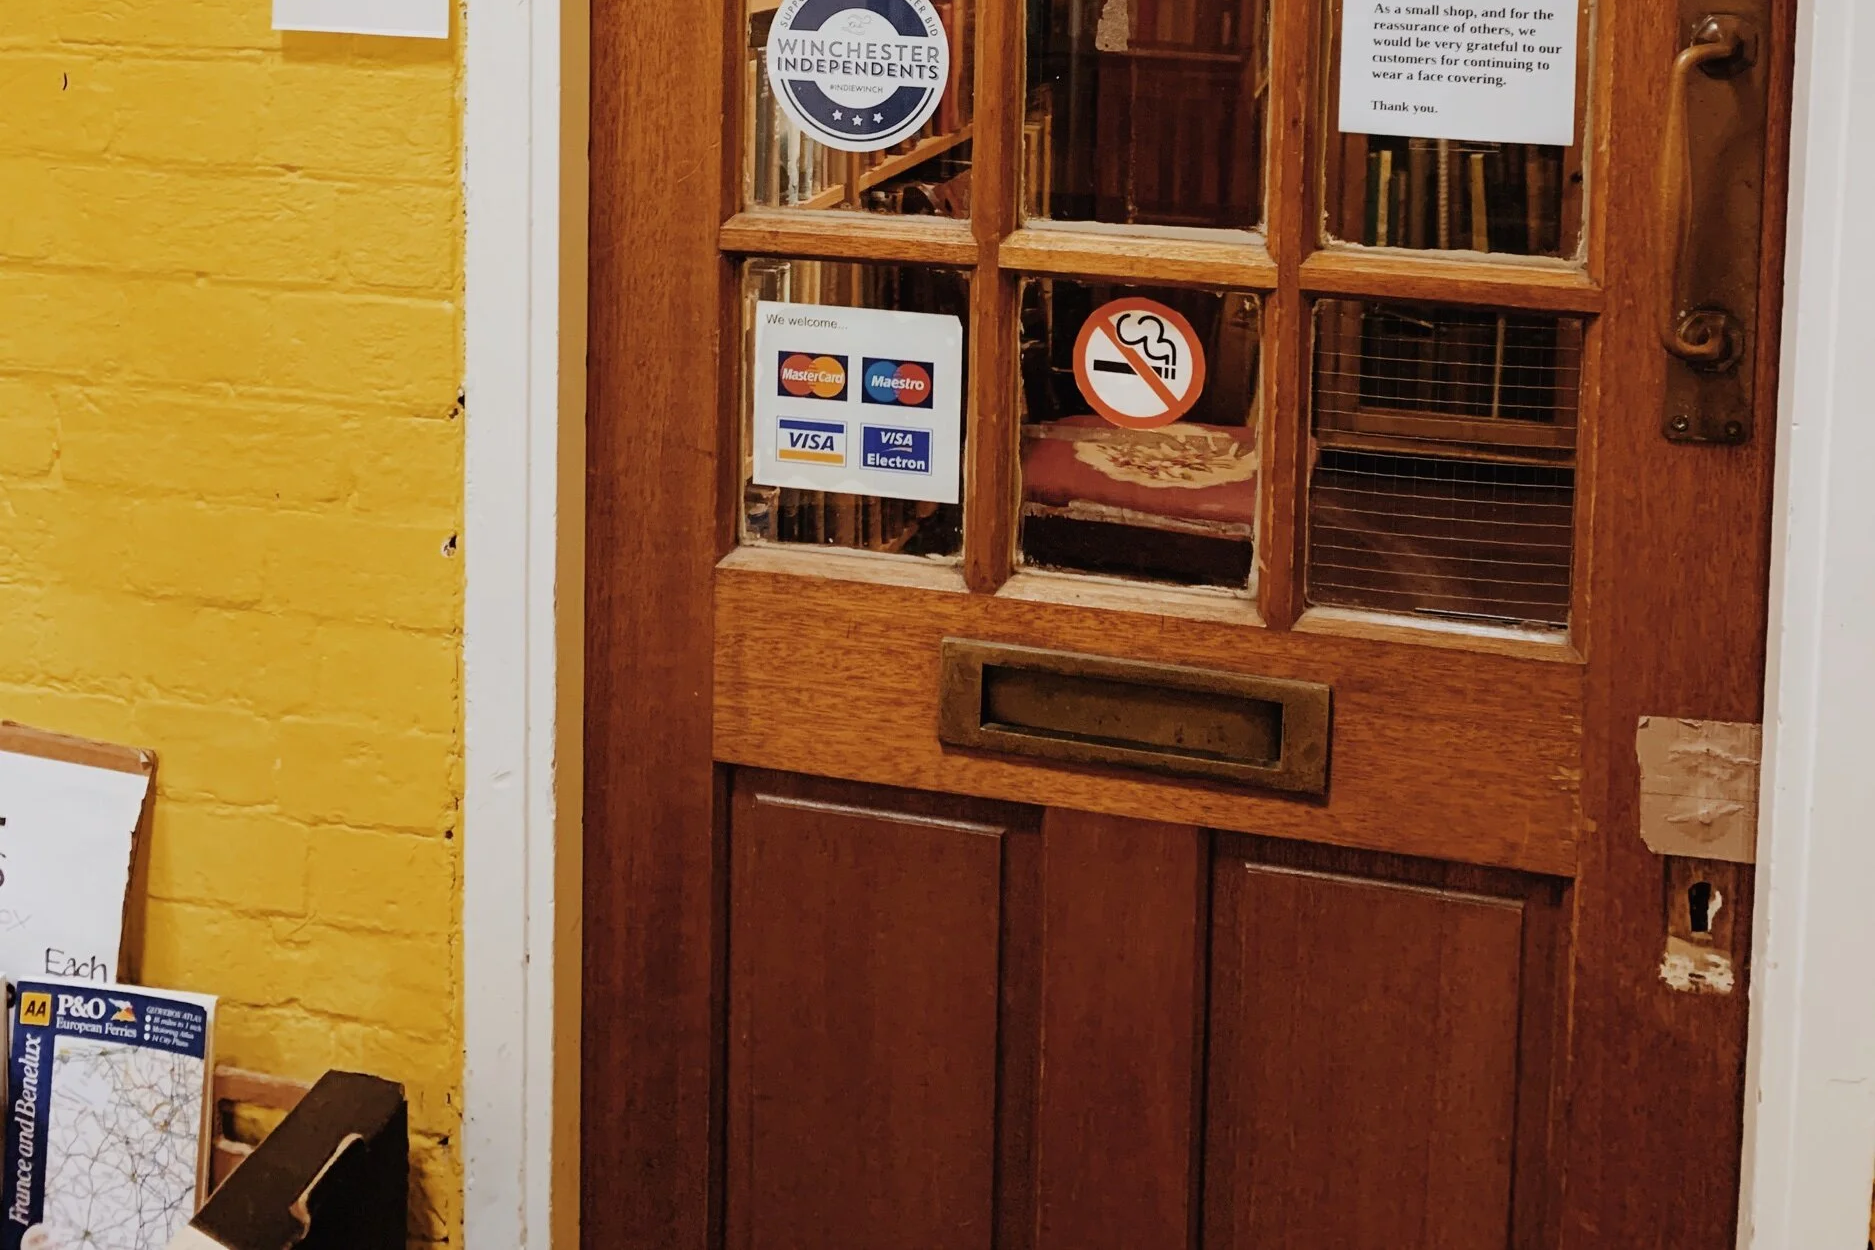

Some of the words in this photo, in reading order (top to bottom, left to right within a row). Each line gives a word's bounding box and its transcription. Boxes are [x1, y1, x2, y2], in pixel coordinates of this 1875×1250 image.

[1374, 3, 1391, 14] As
[1394, 6, 1402, 15] a
[1405, 5, 1439, 16] small
[1443, 6, 1477, 19] shop,
[1481, 8, 1506, 19] and
[1510, 7, 1529, 20] for
[1533, 9, 1554, 21] the
[925, 17, 938, 37] BID
[1373, 20, 1450, 33] reassurance
[1453, 22, 1465, 34] of
[1470, 23, 1514, 37] others,
[1518, 27, 1536, 37] we
[778, 38, 940, 64] WINCHESTER
[1373, 36, 1411, 48] would
[1416, 37, 1430, 49] be
[1435, 40, 1462, 52] very
[1467, 41, 1518, 53] grateful
[1522, 43, 1535, 53] to
[1539, 44, 1562, 55] our
[777, 57, 939, 80] INDEPENDENTS
[1372, 53, 1437, 66] customers
[1441, 54, 1460, 67] for
[1464, 57, 1533, 72] continuing
[1537, 60, 1550, 71] to
[1372, 69, 1403, 81] wear
[1406, 72, 1414, 81] a
[1418, 70, 1443, 82] face
[1447, 72, 1507, 88] covering.
[829, 84, 884, 94] #INDIEWINCH
[1371, 100, 1409, 112] Thank
[1413, 103, 1438, 115] you.
[766, 314, 785, 325] We
[782, 367, 844, 384] MasterCard
[871, 375, 925, 390] Maestro
[789, 432, 835, 452] VISA
[881, 431, 913, 446] VISA
[867, 453, 925, 470] Electron
[45, 948, 107, 983] Each
[25, 1001, 46, 1018] AA
[57, 994, 106, 1019] P&O
[56, 1017, 102, 1034] European
[105, 1023, 137, 1038] Ferries
[15, 1033, 42, 1118] Benelux
[14, 1117, 35, 1158] and
[9, 1158, 32, 1226] France
